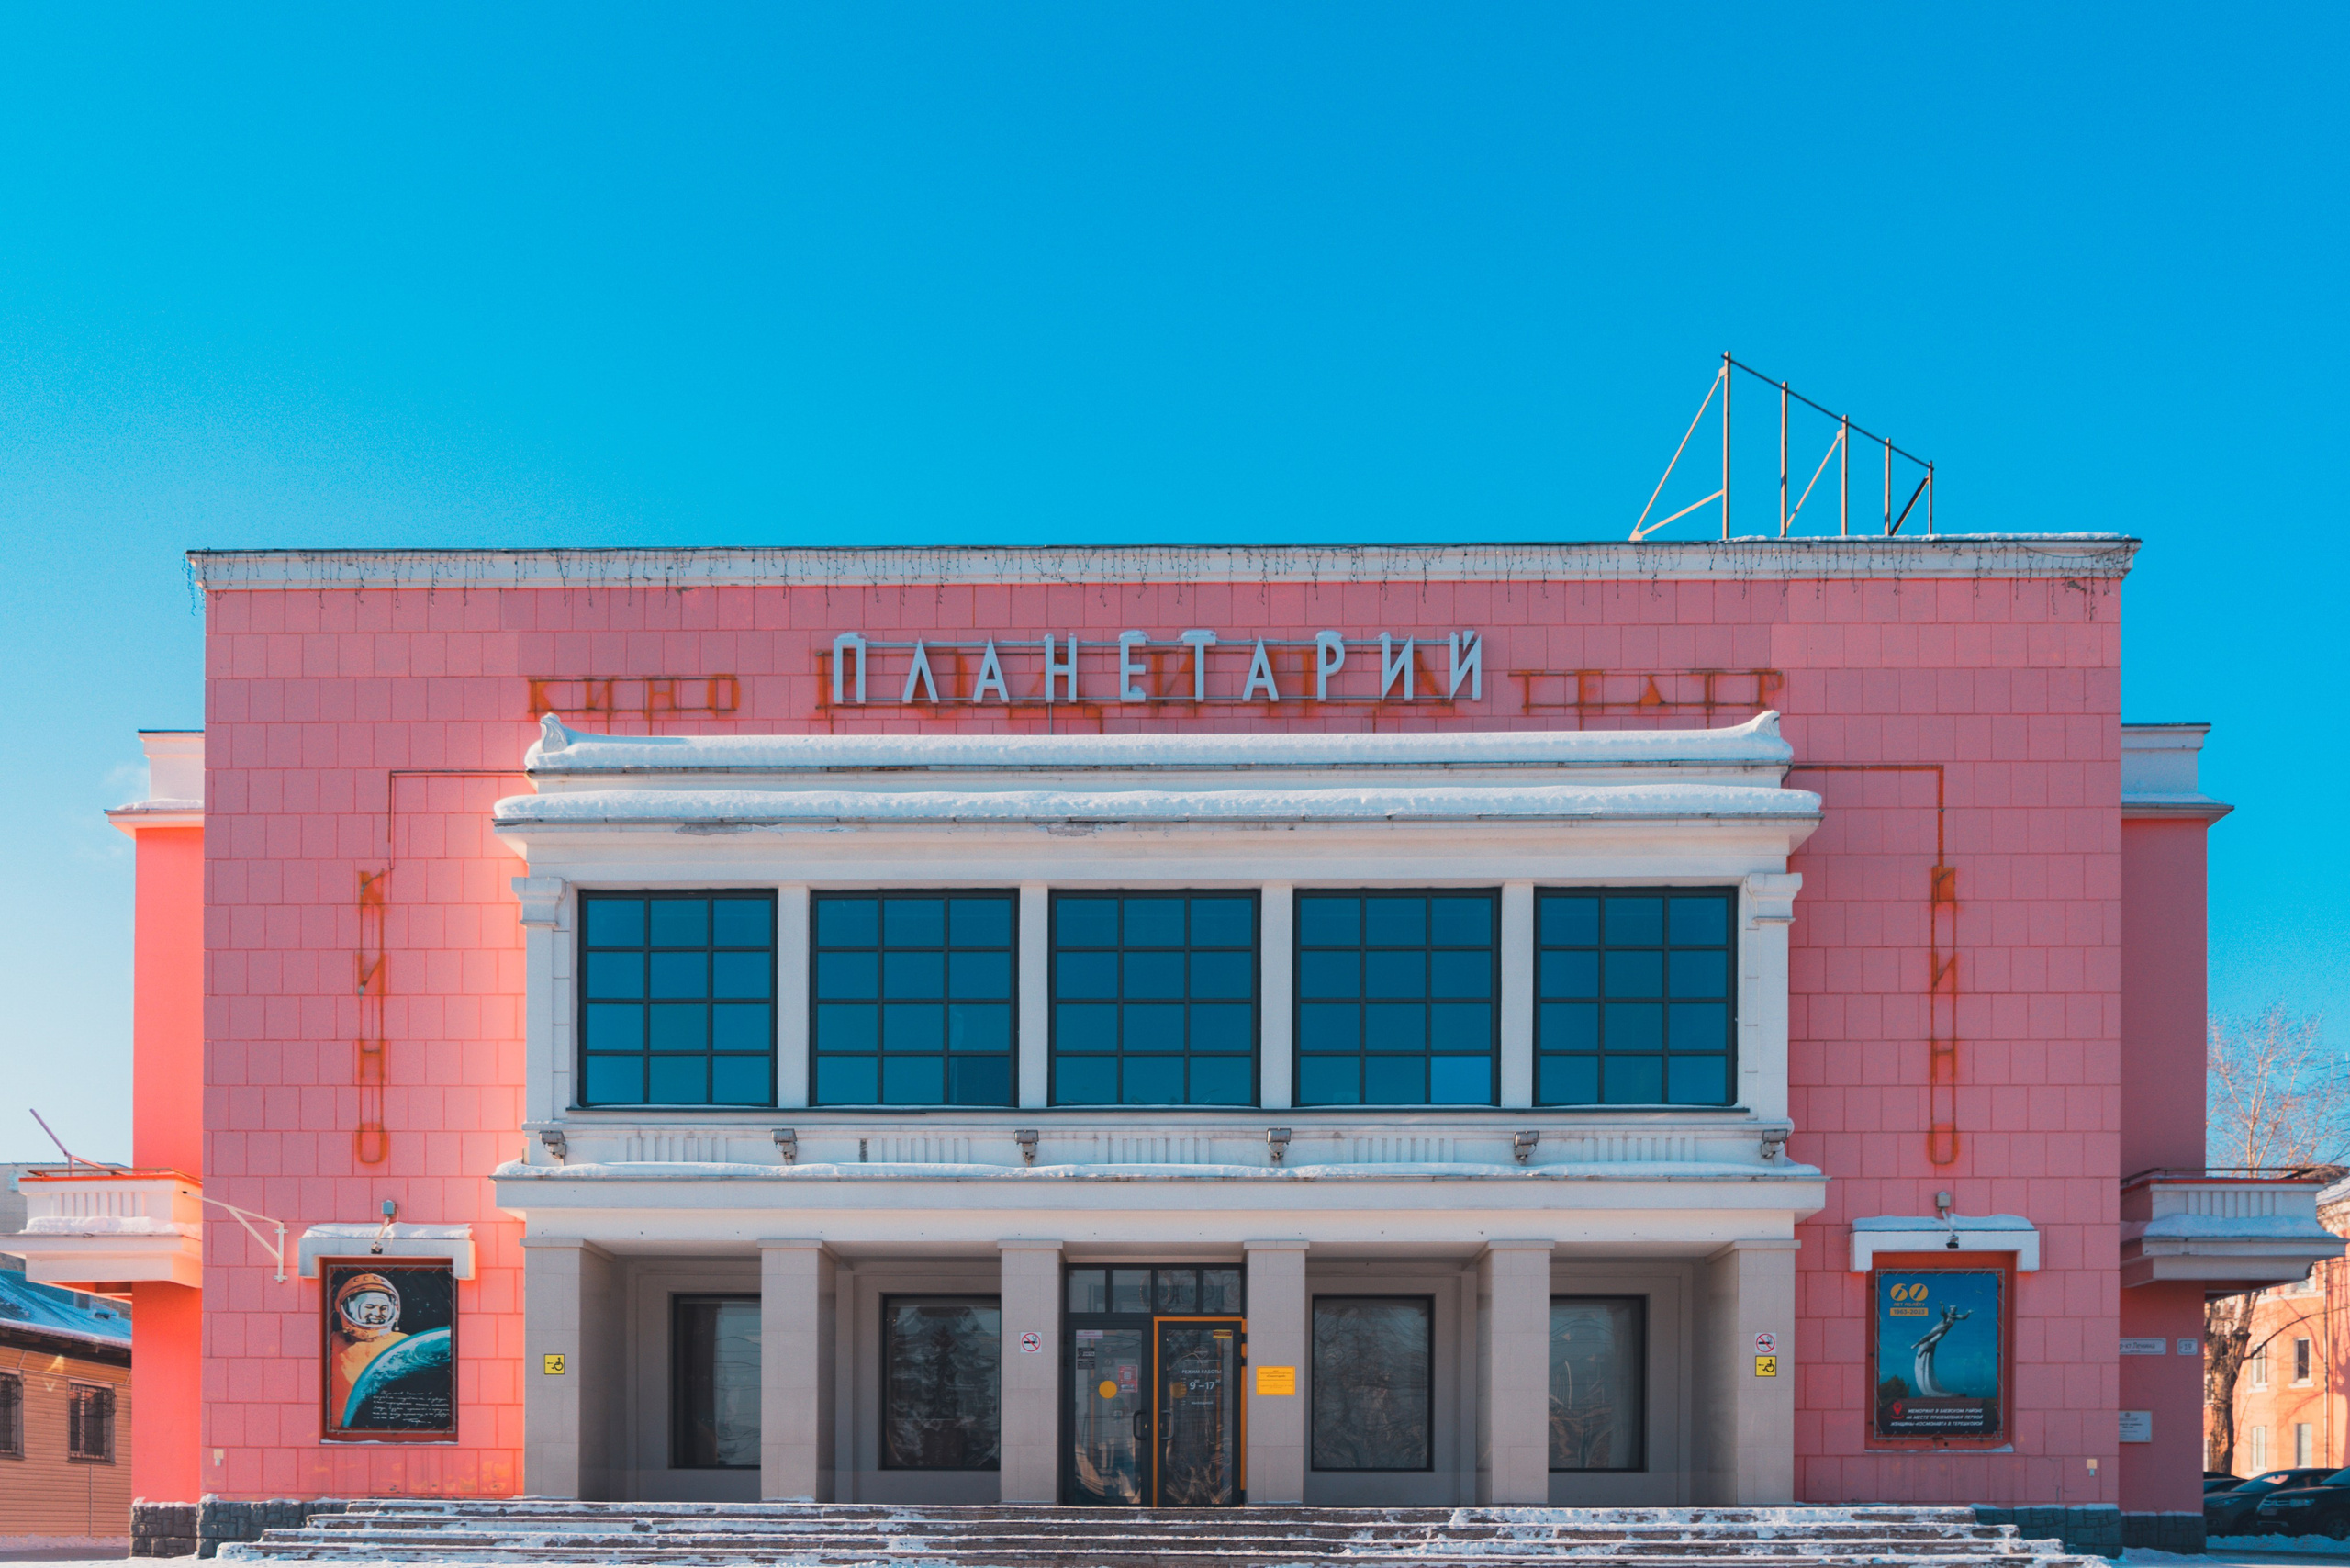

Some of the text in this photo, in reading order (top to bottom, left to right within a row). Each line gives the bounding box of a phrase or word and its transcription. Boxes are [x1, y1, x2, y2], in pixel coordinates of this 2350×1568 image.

[833, 631, 1482, 704] ПЛАНЕТАРИЙ
[1890, 1283, 1928, 1302] 60
[2132, 1341, 2155, 1350] Ленина
